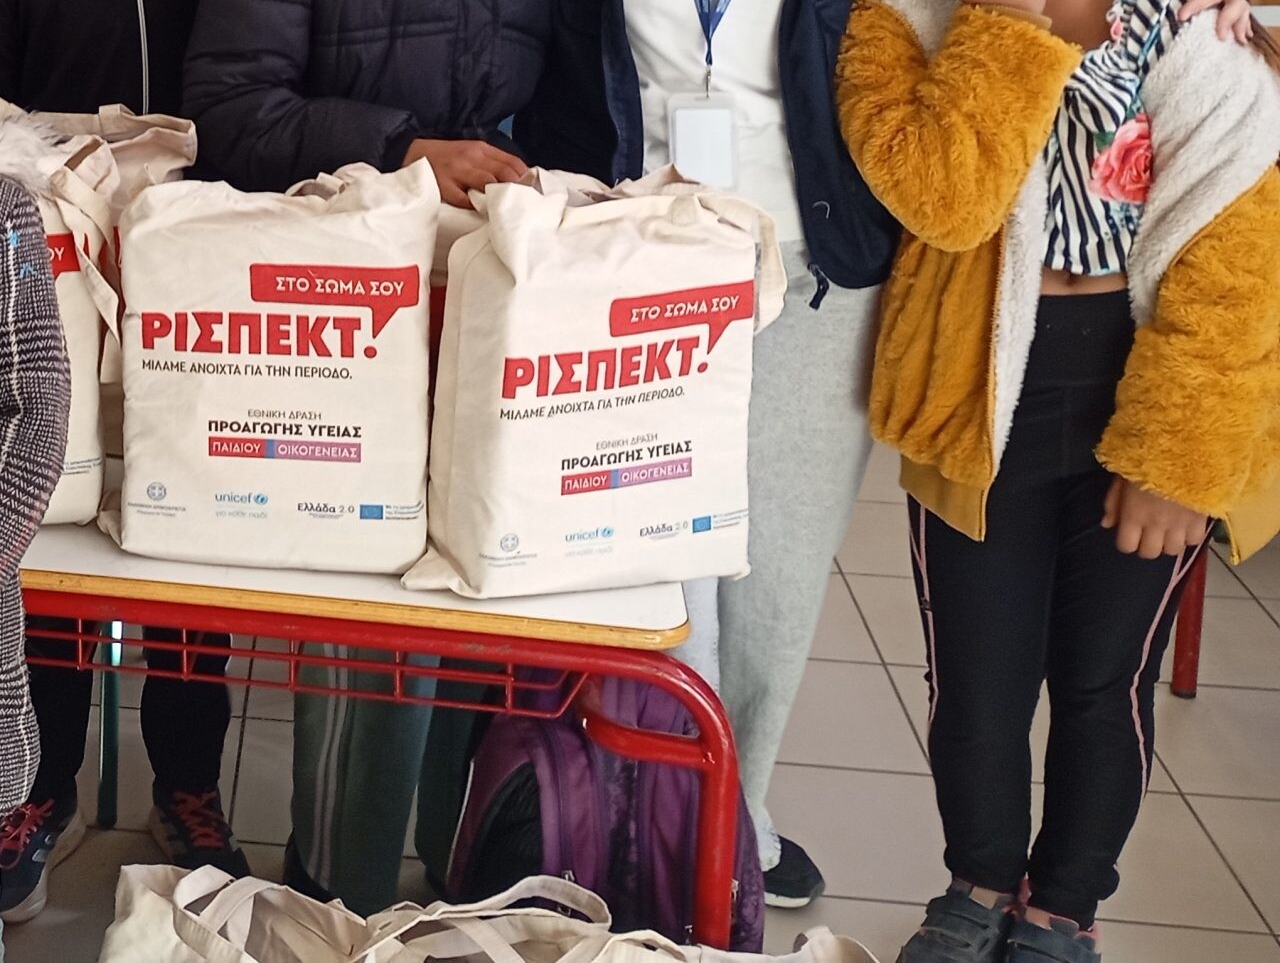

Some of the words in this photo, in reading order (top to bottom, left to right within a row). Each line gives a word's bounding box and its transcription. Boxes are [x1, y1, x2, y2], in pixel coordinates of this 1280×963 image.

[276, 277, 309, 293] ΣΤΟ
[315, 278, 366, 295] ΣΩΜΑ
[370, 280, 405, 296] ΣΟΥ
[630, 306, 660, 323] ΣΤΟ
[664, 301, 708, 318] ΣΩΜΑ
[711, 295, 739, 313] ΣΟΥ
[142, 359, 187, 374] ΜΙΛΑΜΕ
[190, 361, 241, 376] ΑΝΟΙΧΤΑ
[245, 363, 263, 377] ΓΙΑ
[266, 365, 291, 378] ΤΗΝ
[295, 366, 352, 380] ΠΕΡΙΟΔΟ.
[499, 405, 545, 421] ΜΙΛΑΜΕ
[547, 400, 595, 418] ΑΝΟΙΧΤΑ
[597, 397, 613, 411] ΓΙΑ
[615, 393, 636, 408] ΤΗΝ
[637, 387, 685, 404] ΠΕΡΙΟΔΟ.
[247, 408, 286, 420] ΕΘΝΙΚΗ
[288, 410, 322, 421] ΔΡΑΣΗ
[208, 420, 303, 436] ΠΡΟΑΓΩΓΗΣ
[308, 423, 362, 438] ΥΓΕΙΑΣ
[212, 441, 262, 455] ΠΑΙΔΙΟΥ
[277, 443, 357, 459] ΟΙΚΟΓΕΝΕΙΑΣ
[596, 437, 629, 450] ΕΘΝΙΚΗ
[630, 433, 658, 446] ΔΡΑΣΗ
[561, 449, 643, 471] ΠΡΟΑΓΩΓΗΣ
[647, 441, 692, 460] ΥΓΕΙΑΣ
[564, 474, 607, 492] ΠΑΙΔΙΟΥ
[621, 462, 689, 483] ΟΙΚΟΓΕΝΕΙΑΣ
[215, 492, 252, 504] unicef
[297, 503, 336, 513] Ελλάδα
[565, 528, 599, 542] unicef
